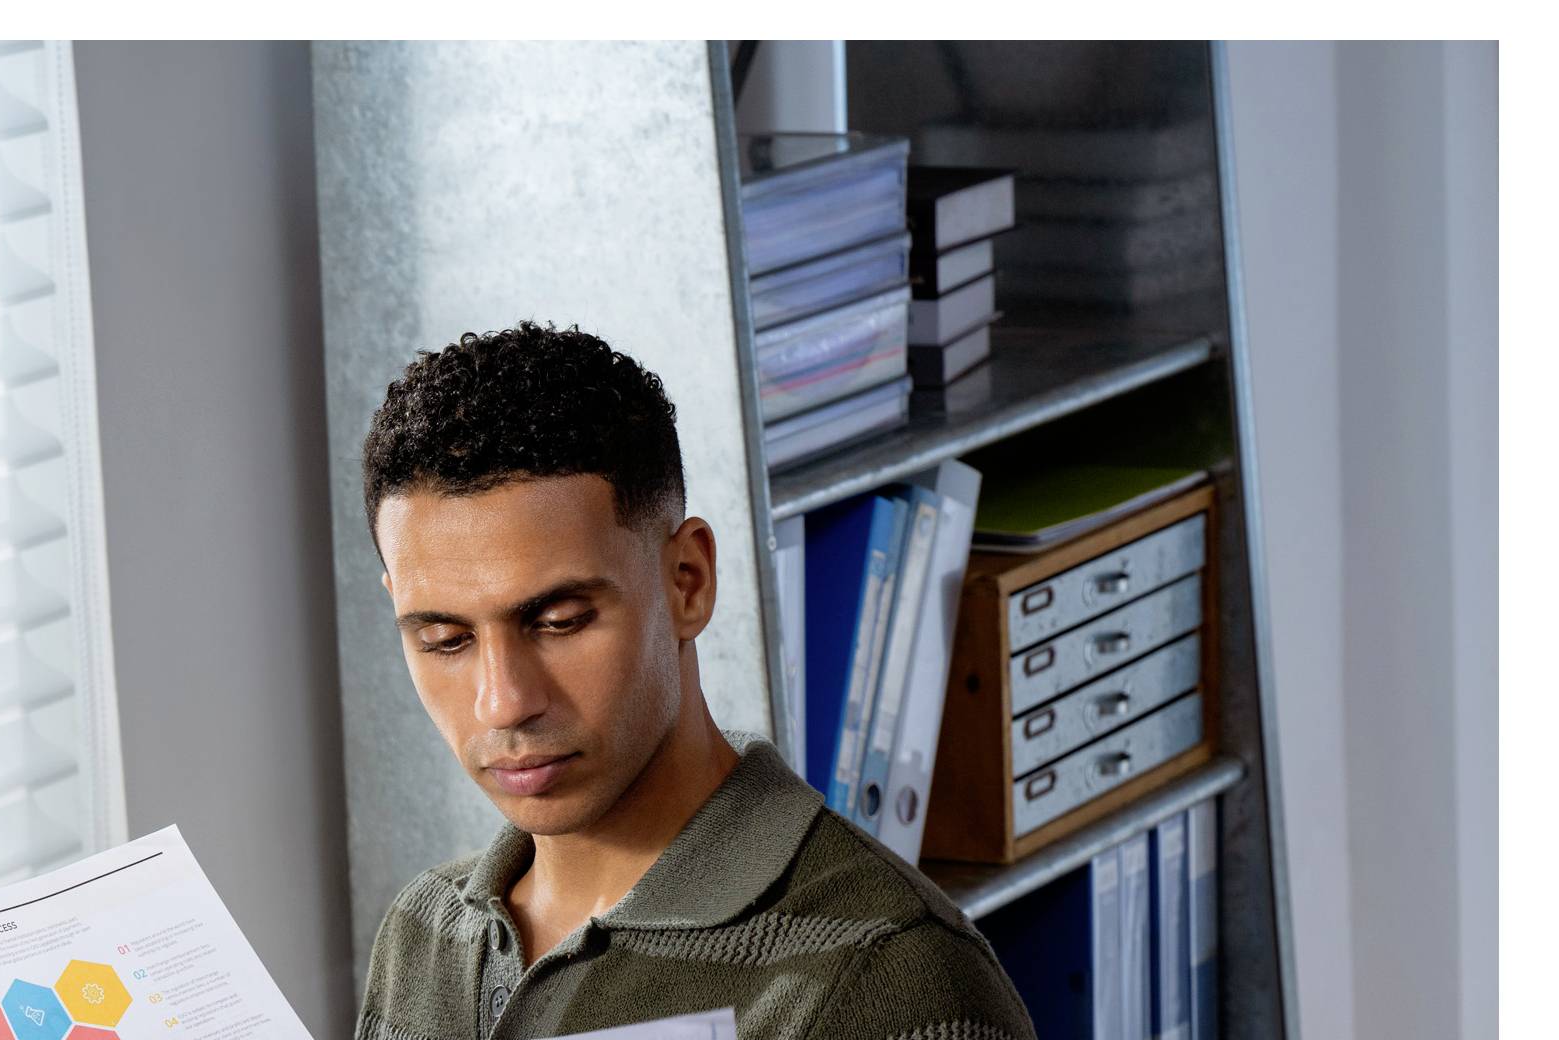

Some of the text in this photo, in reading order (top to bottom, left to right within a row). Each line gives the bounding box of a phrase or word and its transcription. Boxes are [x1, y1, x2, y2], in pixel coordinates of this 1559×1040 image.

[117, 944, 131, 955] 01
[133, 969, 148, 980] 02
[164, 1017, 179, 1029] 04
